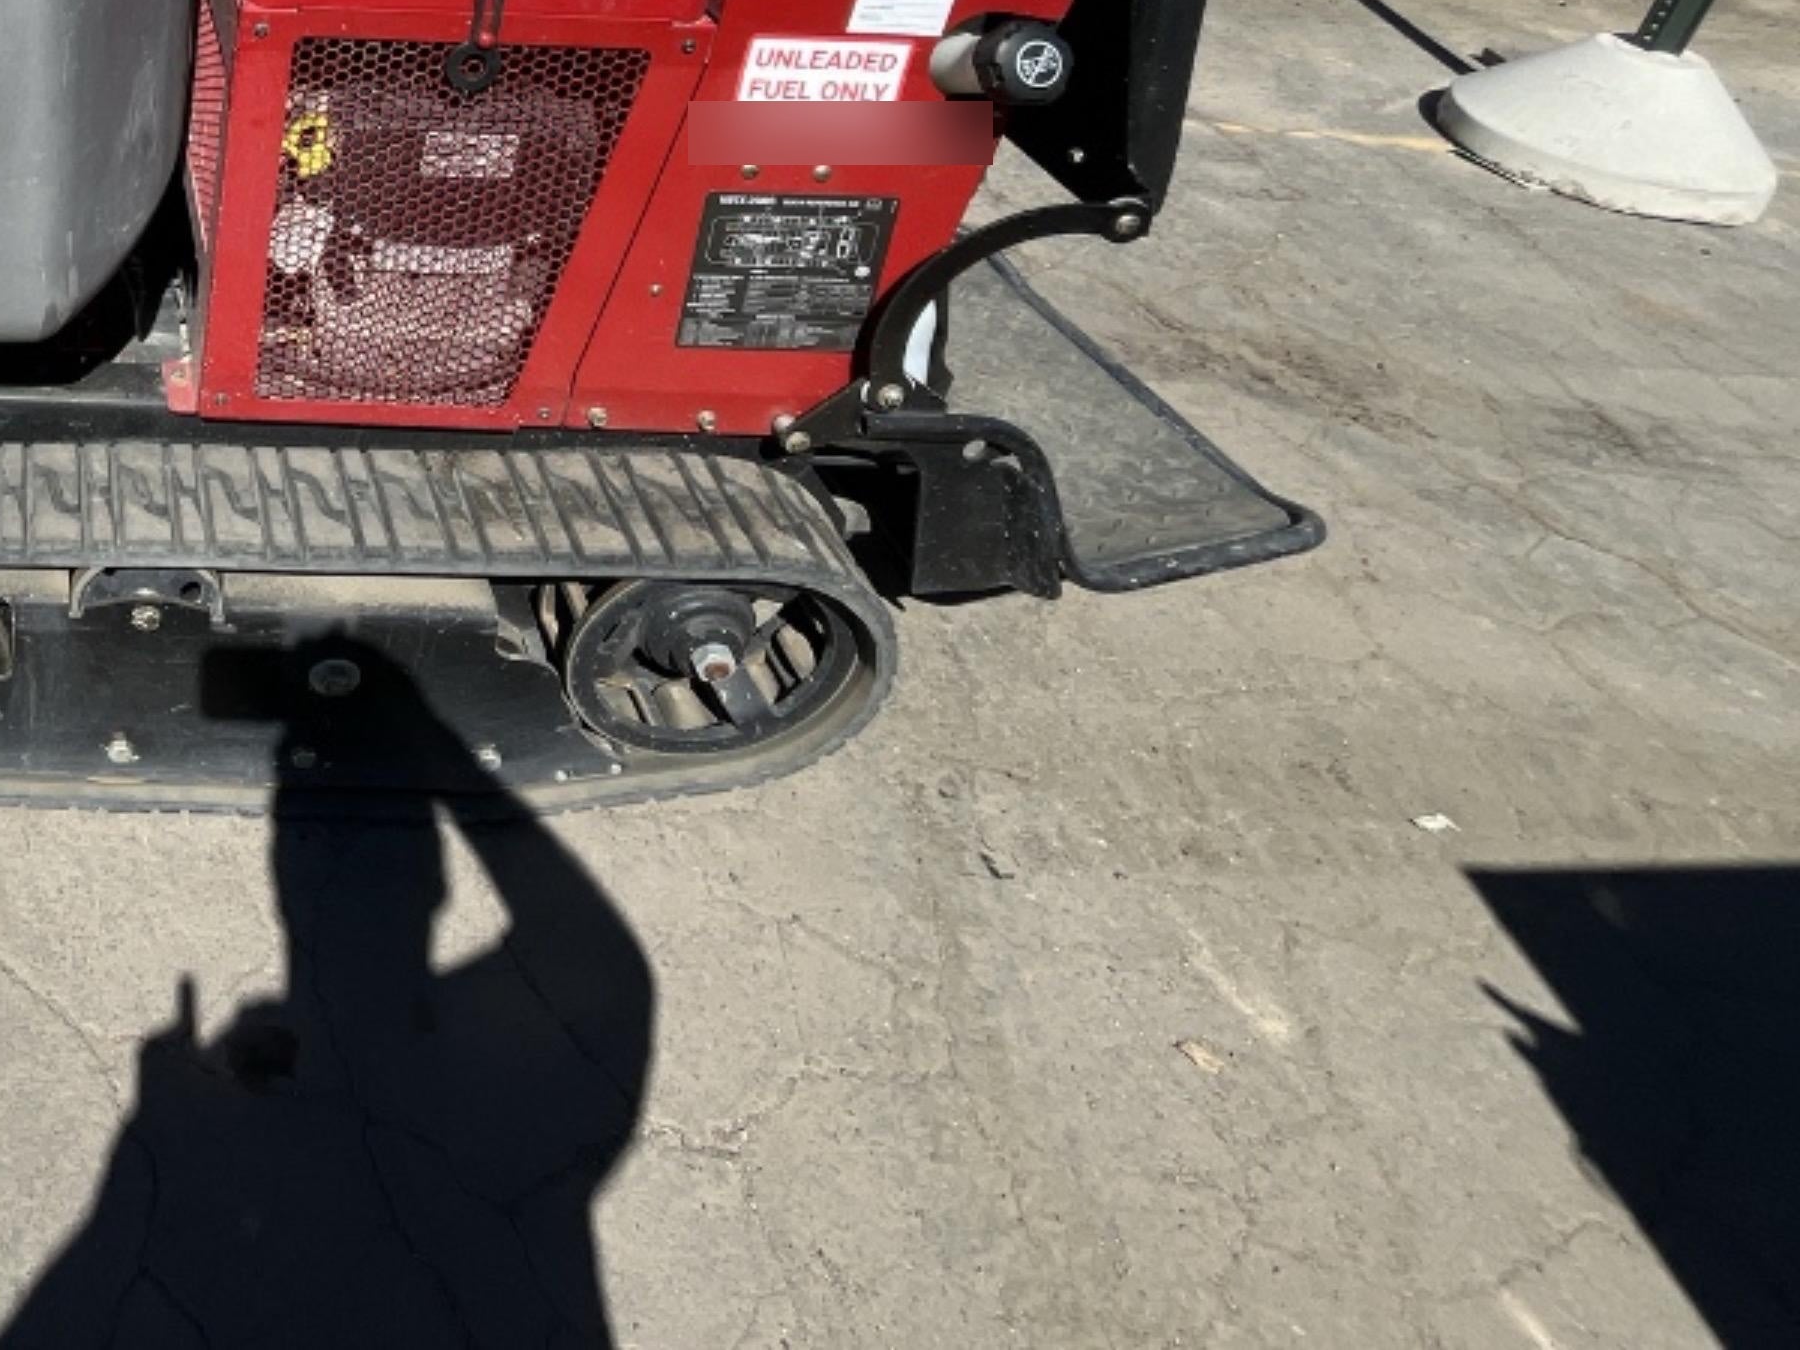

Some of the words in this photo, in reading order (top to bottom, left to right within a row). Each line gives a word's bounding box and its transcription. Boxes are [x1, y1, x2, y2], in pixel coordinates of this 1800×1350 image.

[755, 48, 899, 73] UNLEADED
[747, 78, 812, 100] FUEL
[820, 79, 893, 102] ONLY
